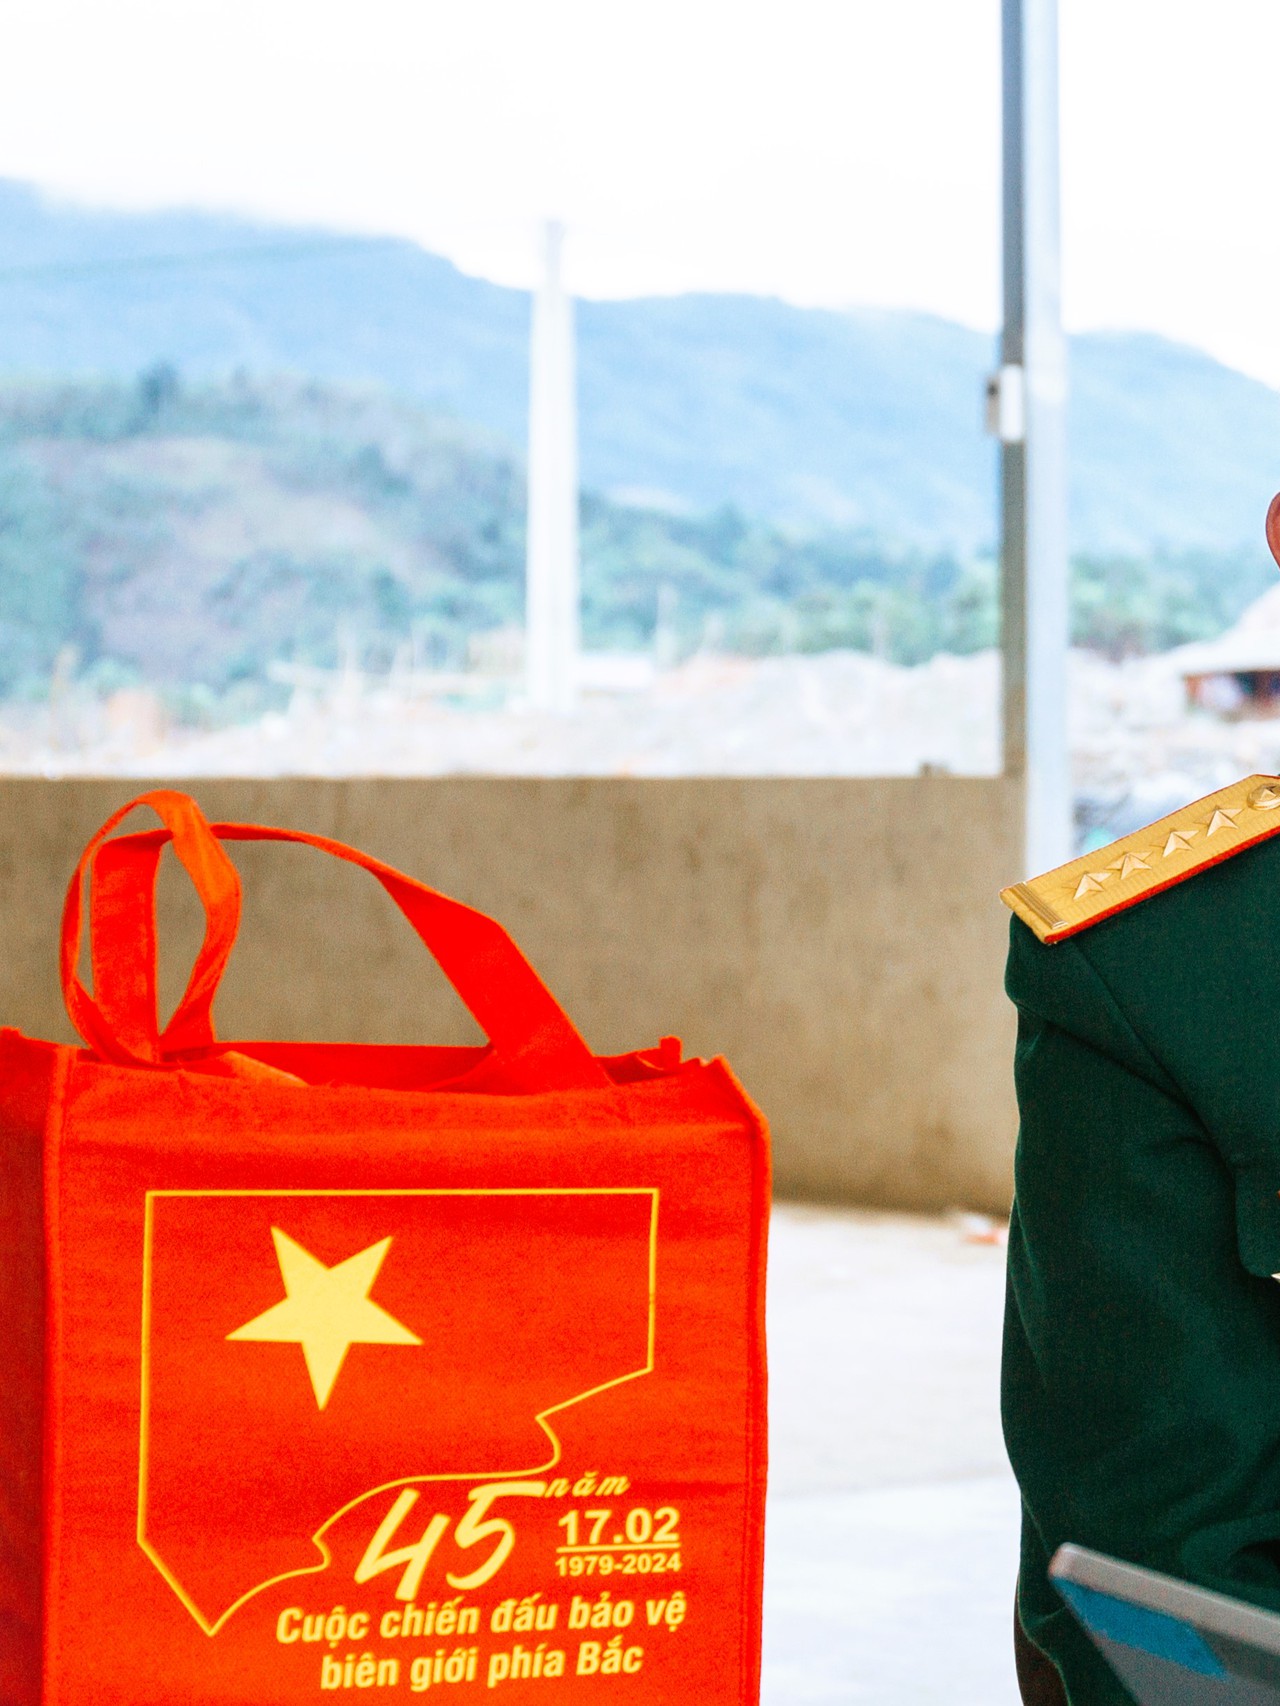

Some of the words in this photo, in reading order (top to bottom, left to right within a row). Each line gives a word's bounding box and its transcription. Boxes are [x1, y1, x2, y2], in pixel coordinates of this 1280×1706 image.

[354, 1481, 547, 1601] 45
[544, 1471, 631, 1498] năm
[558, 1506, 681, 1545] 17.02
[555, 1552, 683, 1577] 1979-2024
[276, 1606, 370, 1648] Cuộc
[380, 1593, 480, 1639] chiến
[490, 1592, 558, 1633] đấu
[568, 1591, 634, 1630] bảo
[646, 1591, 687, 1633] vệ
[321, 1651, 400, 1690] biên
[410, 1646, 478, 1692] giới
[487, 1643, 565, 1689] phía
[576, 1634, 644, 1676] Bắc
